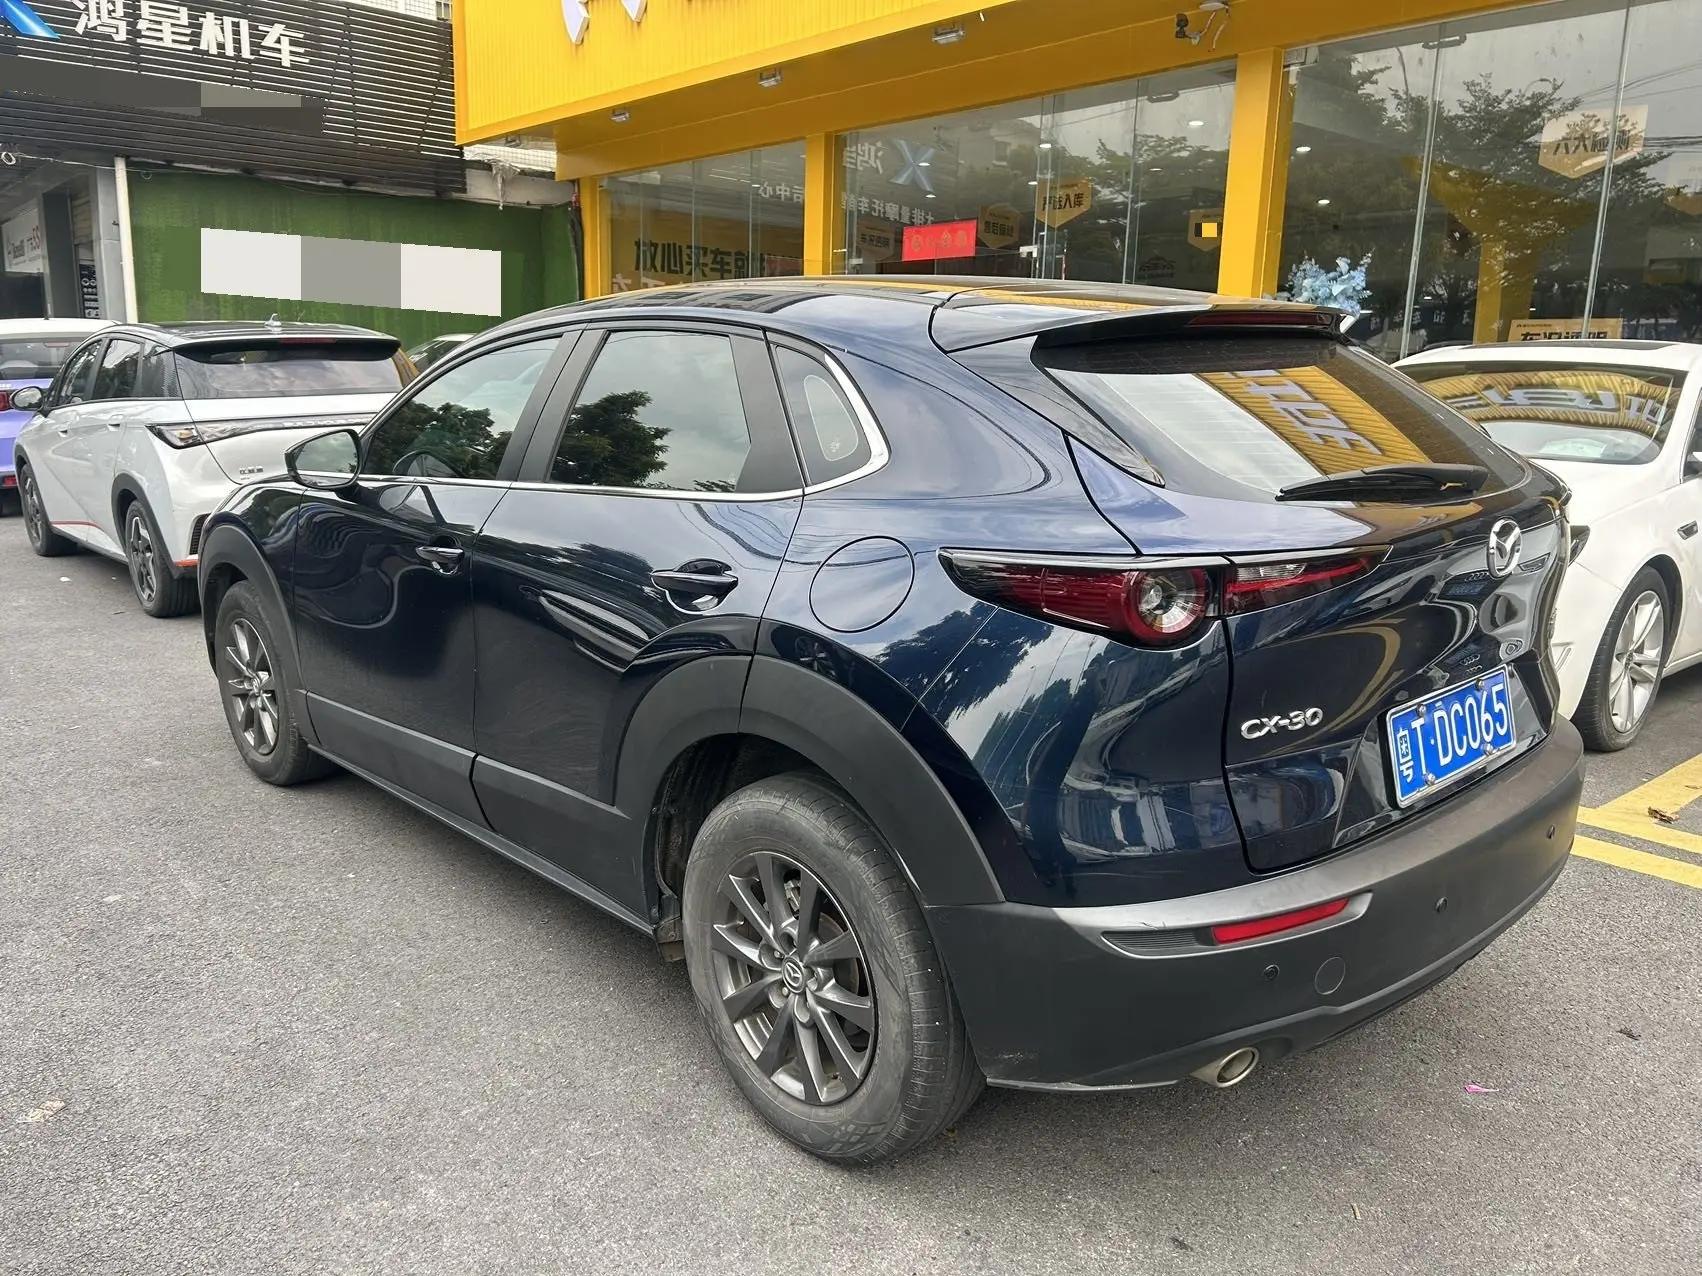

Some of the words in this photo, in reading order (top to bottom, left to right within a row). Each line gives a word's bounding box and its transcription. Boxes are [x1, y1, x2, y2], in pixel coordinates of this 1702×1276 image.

[73, 0, 309, 68] 鸿星机车
[1241, 707, 1323, 739] CX-30
